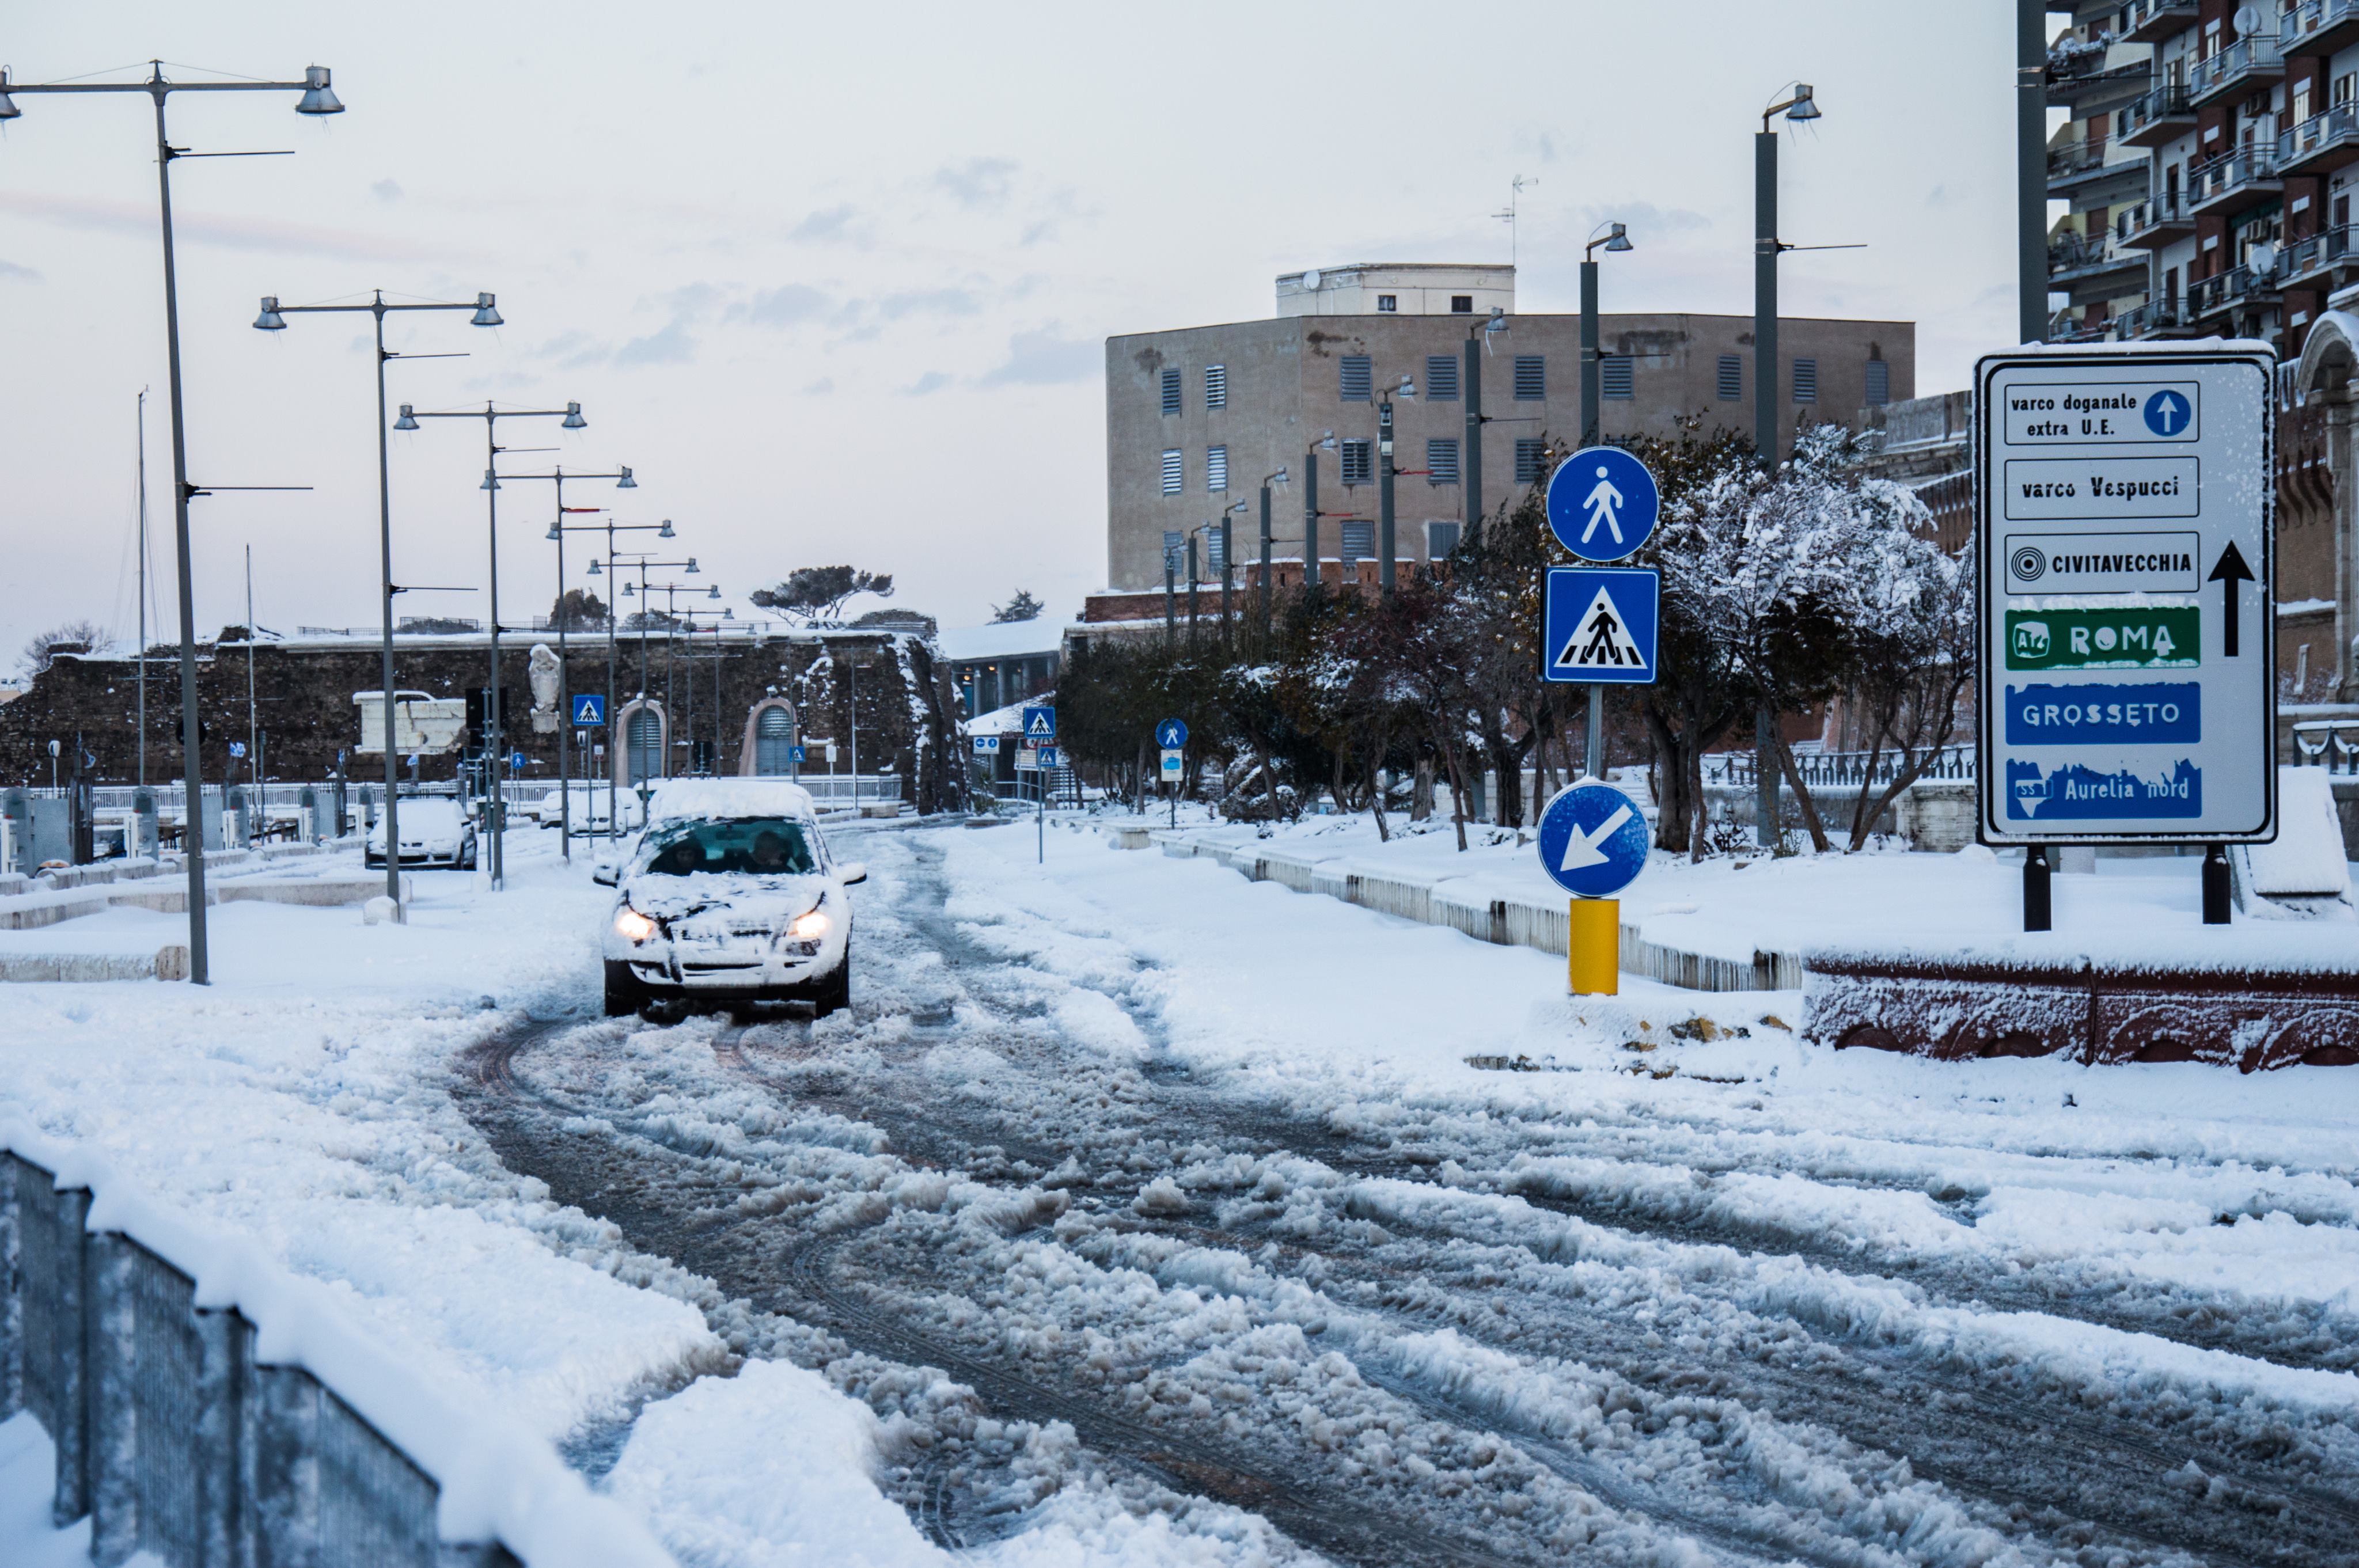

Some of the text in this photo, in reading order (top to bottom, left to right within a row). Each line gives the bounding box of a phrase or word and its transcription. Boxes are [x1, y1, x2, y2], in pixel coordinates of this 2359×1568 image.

[2011, 393, 2137, 413] varco doganale
[2027, 419, 2115, 436] extra U.E.
[2022, 476, 2178, 501] varco Vespucci
[2052, 554, 2191, 573] CIVITAVECCHIA
[2070, 625, 2176, 656] ROMA
[2023, 704, 2179, 727] GROSSETO
[2065, 778, 2134, 800] Aurelia
[2148, 777, 2189, 799] nord
